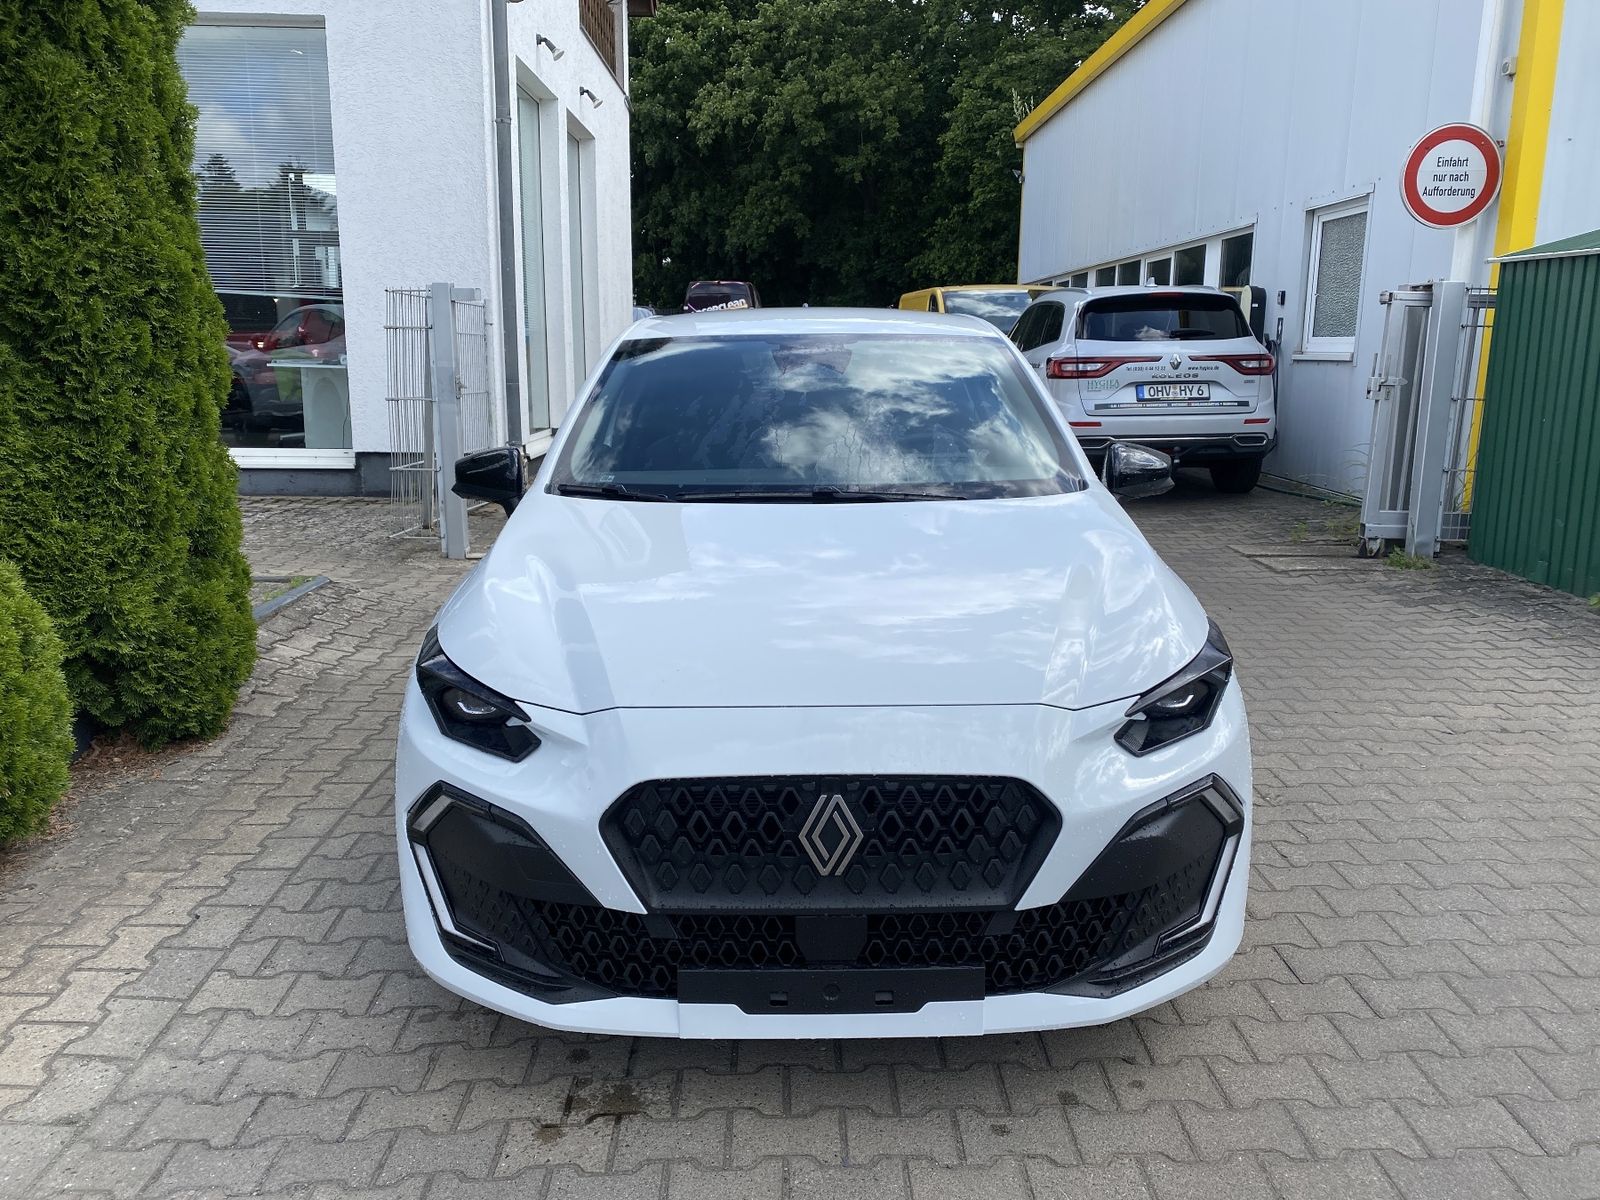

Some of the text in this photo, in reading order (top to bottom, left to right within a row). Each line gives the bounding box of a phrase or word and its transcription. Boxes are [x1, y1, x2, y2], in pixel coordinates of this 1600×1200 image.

[1436, 156, 1469, 168] Einfahrt
[1432, 171, 1470, 182] nur nach
[1422, 186, 1476, 199] Aufforderung
[1148, 386, 1204, 397] OHV HY 6
